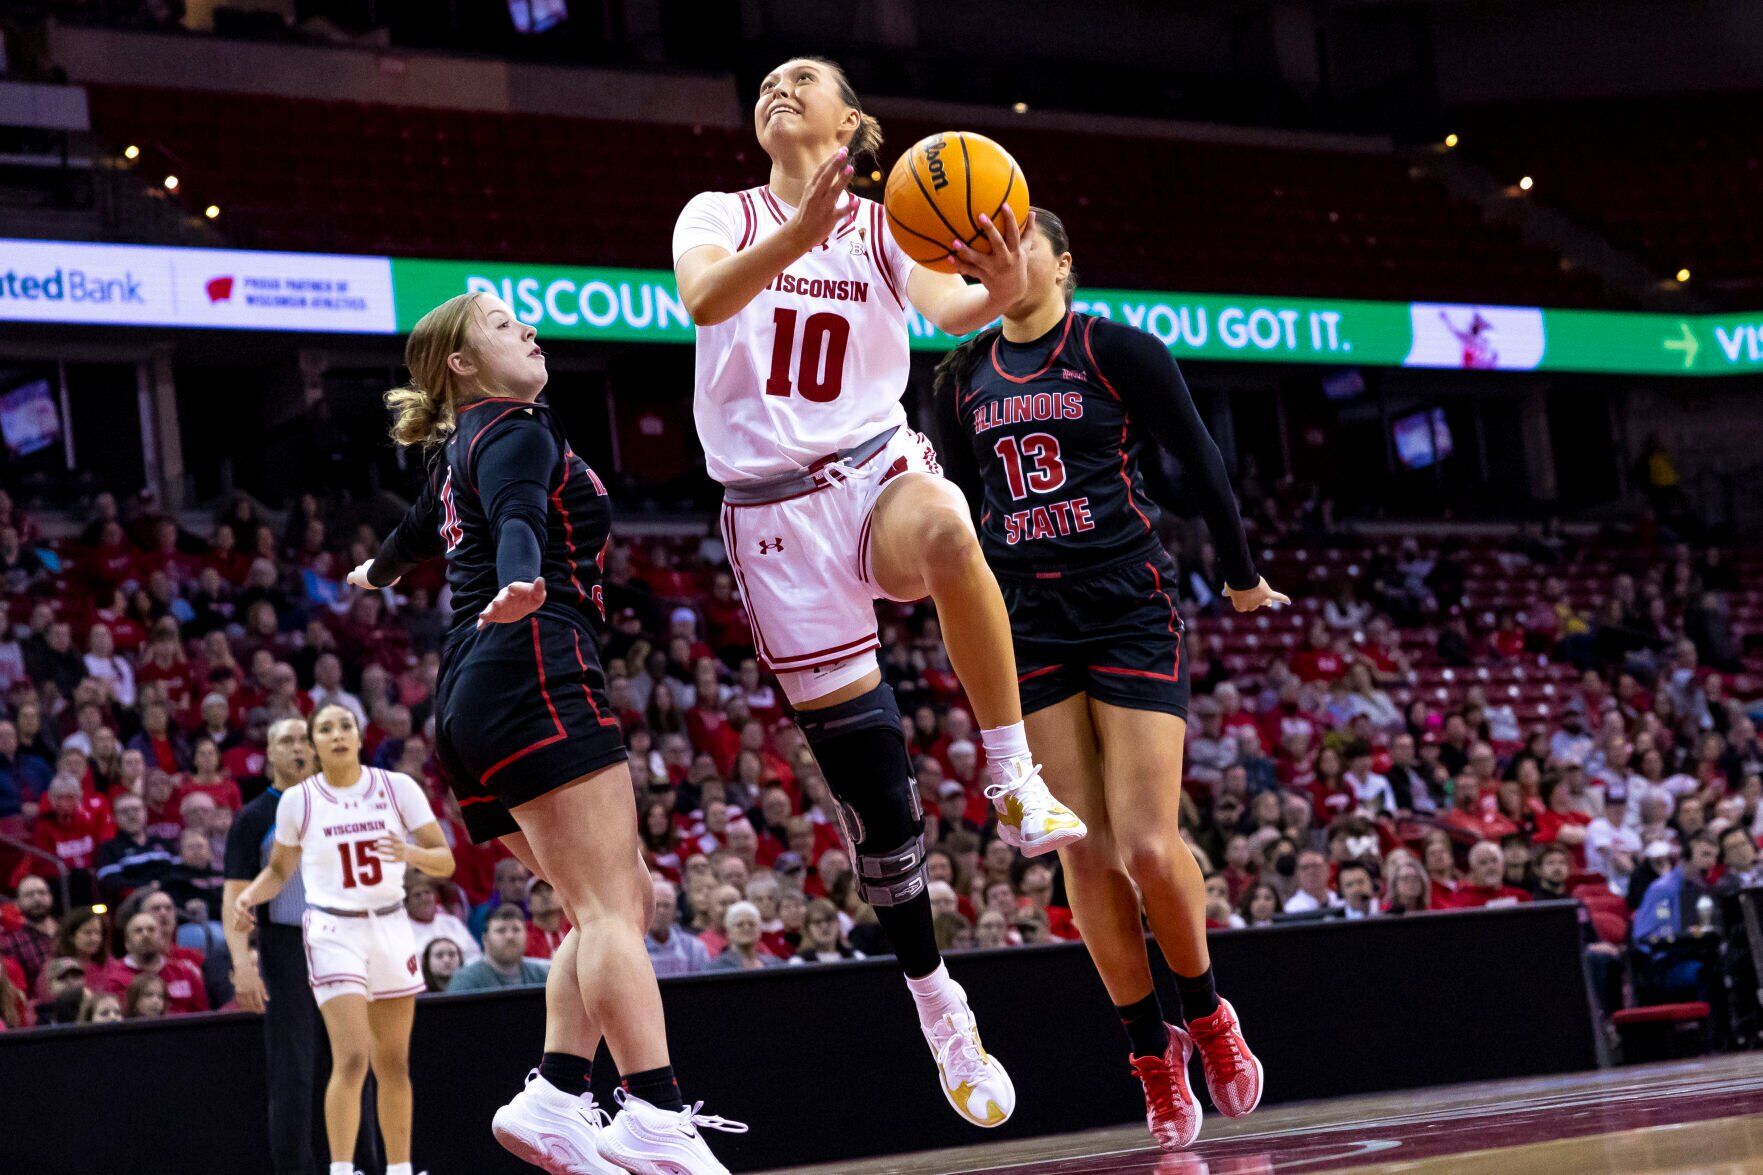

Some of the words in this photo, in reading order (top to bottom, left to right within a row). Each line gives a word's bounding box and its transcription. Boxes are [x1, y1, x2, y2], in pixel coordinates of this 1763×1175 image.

[68, 269, 144, 304] Bank
[1121, 302, 1208, 349] YOU
[1217, 306, 1299, 351] GOT
[1309, 310, 1352, 352] IT.
[766, 307, 851, 404] 10
[972, 391, 1084, 435] ILLINOIS
[993, 432, 1067, 501] 13
[1003, 496, 1096, 546] STATE
[322, 820, 386, 838] WISCONSIN
[337, 839, 383, 889] 15
